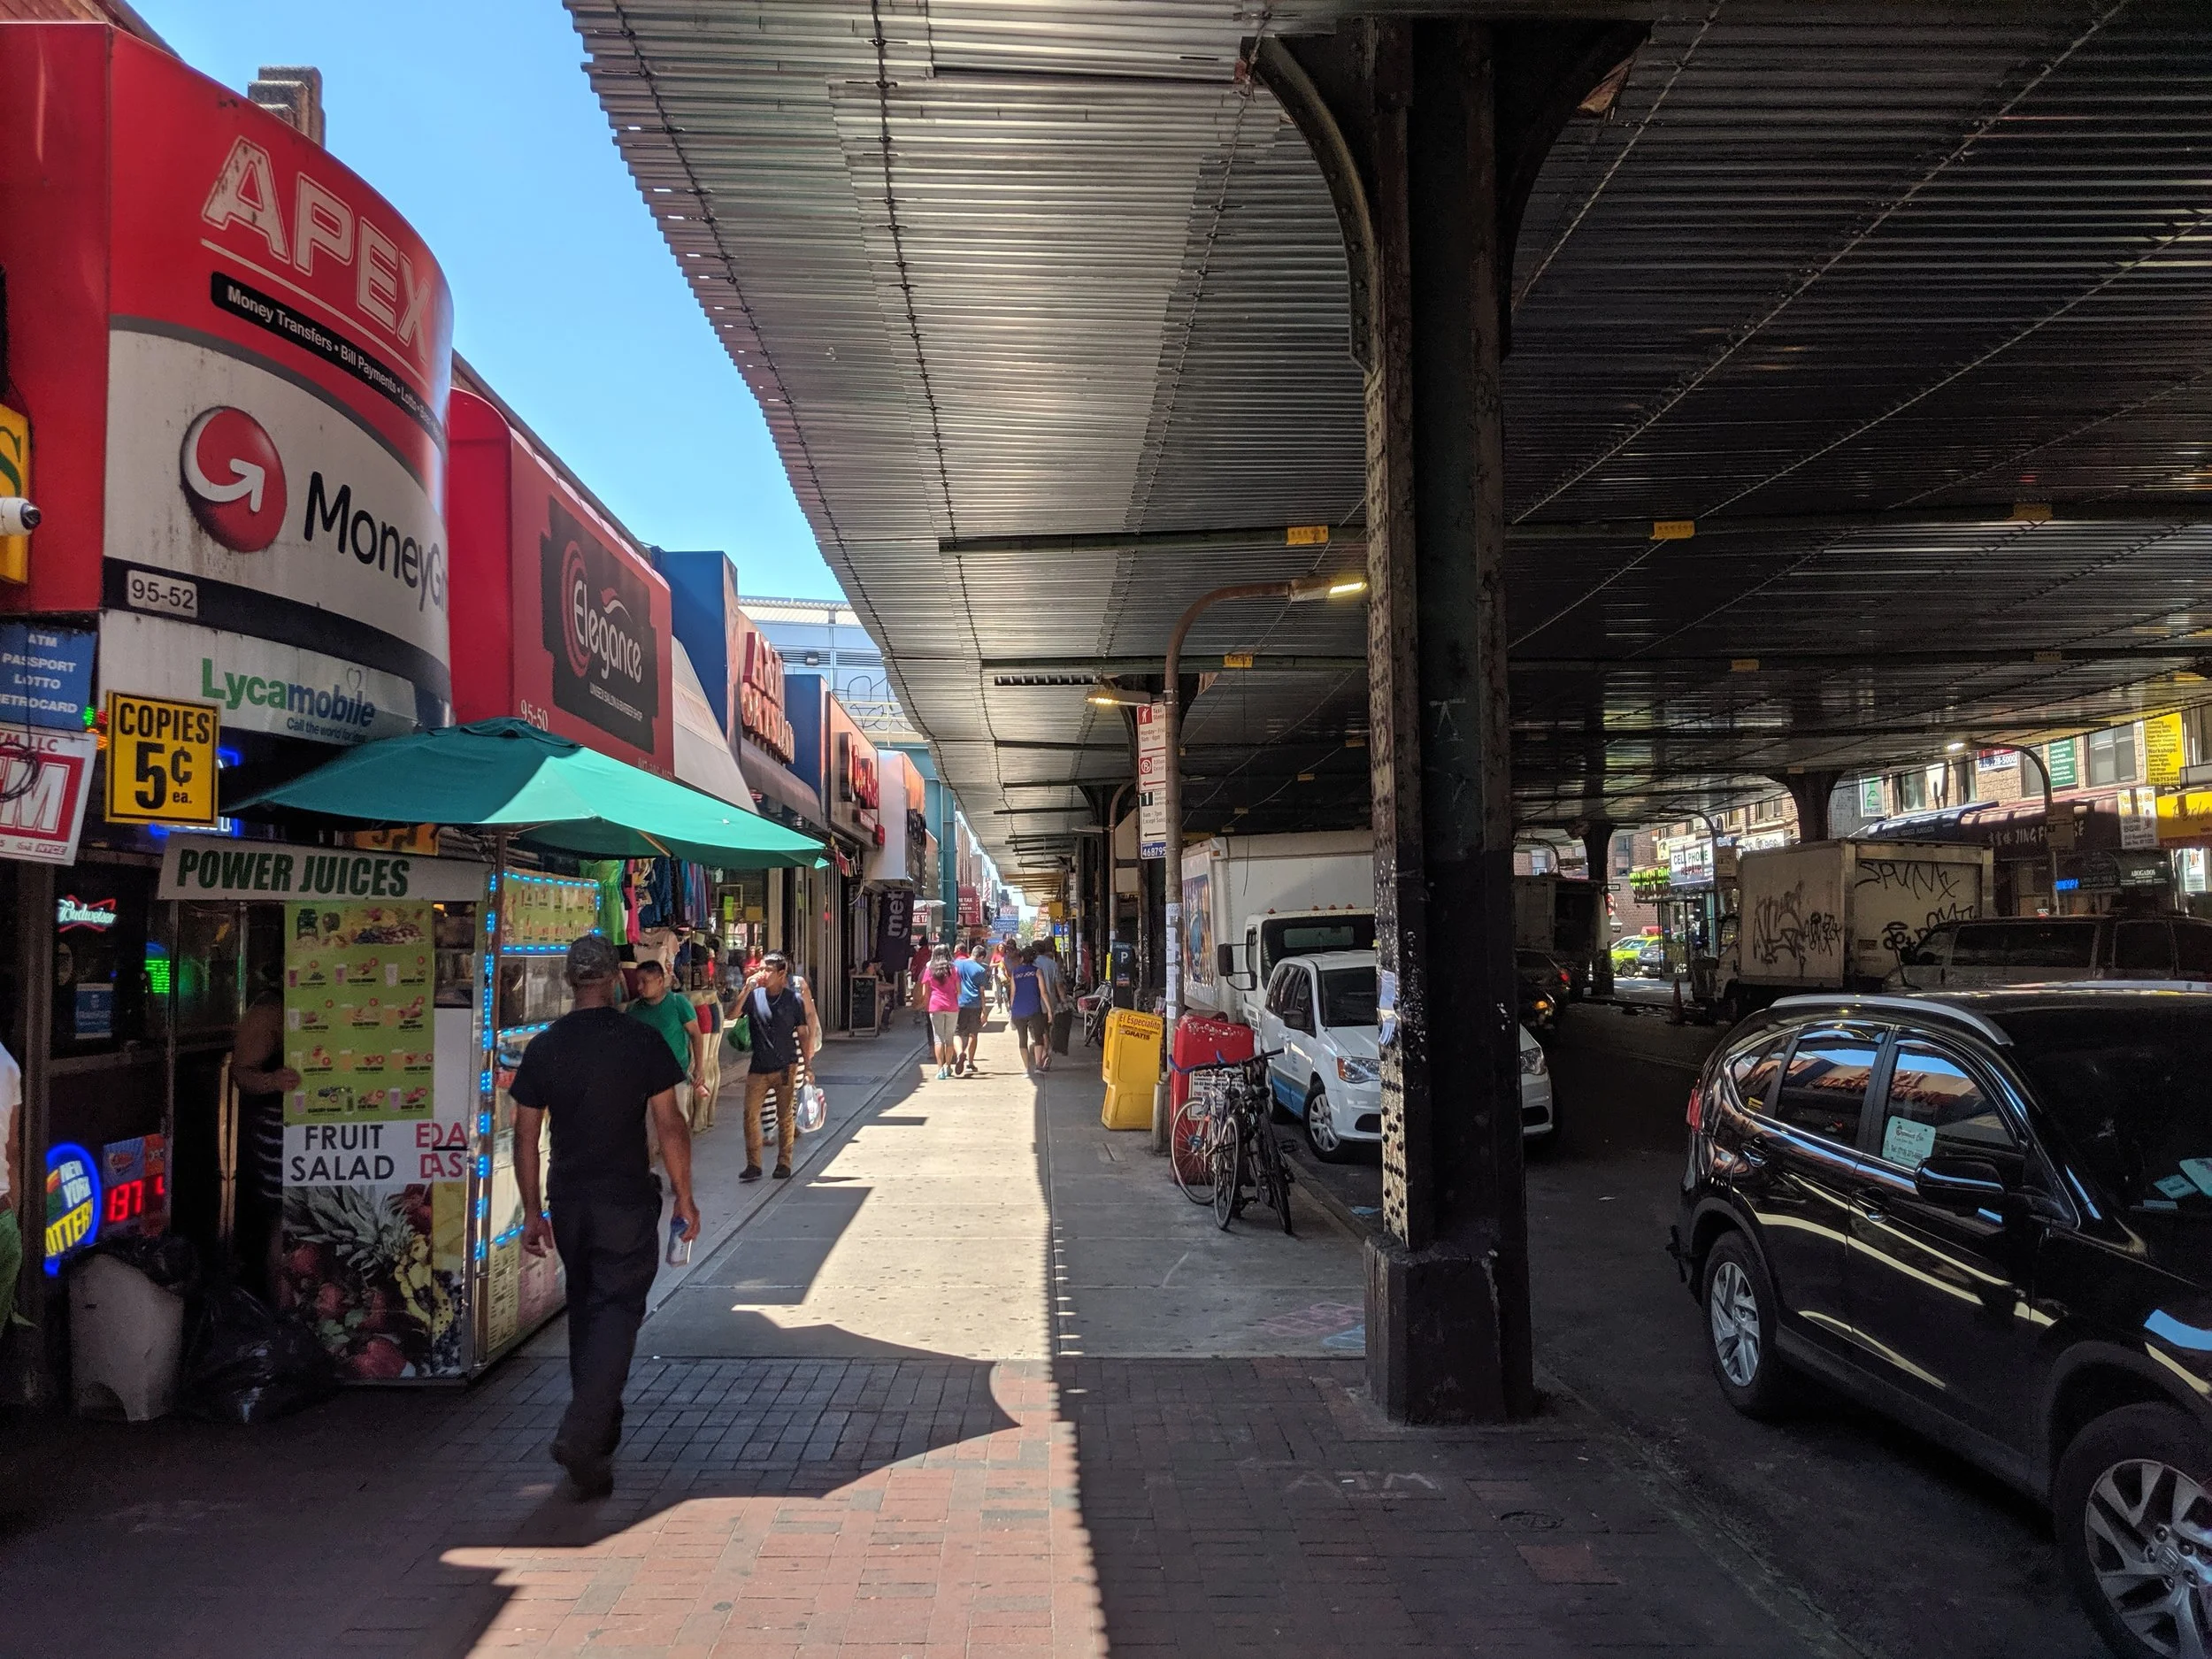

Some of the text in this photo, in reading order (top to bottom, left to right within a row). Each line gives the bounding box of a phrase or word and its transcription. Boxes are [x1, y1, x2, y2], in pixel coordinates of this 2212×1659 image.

[201, 134, 432, 366] APEX
[227, 284, 274, 324] Money
[276, 309, 333, 352] Transfers
[341, 344, 357, 365] Bill
[358, 355, 396, 392] Payments
[132, 577, 195, 611] 95-52
[28, 634, 58, 648] ATM
[574, 580, 642, 683] Elegance
[3, 652, 77, 672] PASSPORT
[14, 673, 61, 689] LOTTO
[202, 657, 375, 727] Lycamobile
[0, 693, 79, 713] ETROCARD
[520, 700, 549, 731] 95-50
[119, 703, 210, 744] COPIES
[287, 718, 304, 733] Call
[305, 718, 319, 735] the
[173, 791, 193, 804] ea.
[1673, 850, 1709, 865] CELL PHONE
[1681, 865, 1703, 875] REPAIR
[177, 848, 410, 897] POWER JUICES
[58, 898, 117, 925] Budweiser
[1119, 1014, 1125, 1023] El
[1126, 1015, 1161, 1030] Especialito
[1125, 1029, 1150, 1041] GRATIS
[304, 1124, 384, 1150] FRUIT
[59, 1160, 84, 1183] NEW
[290, 1155, 395, 1181] SALAD
[63, 1176, 91, 1208] YORK
[46, 1197, 94, 1256] OTTERY
